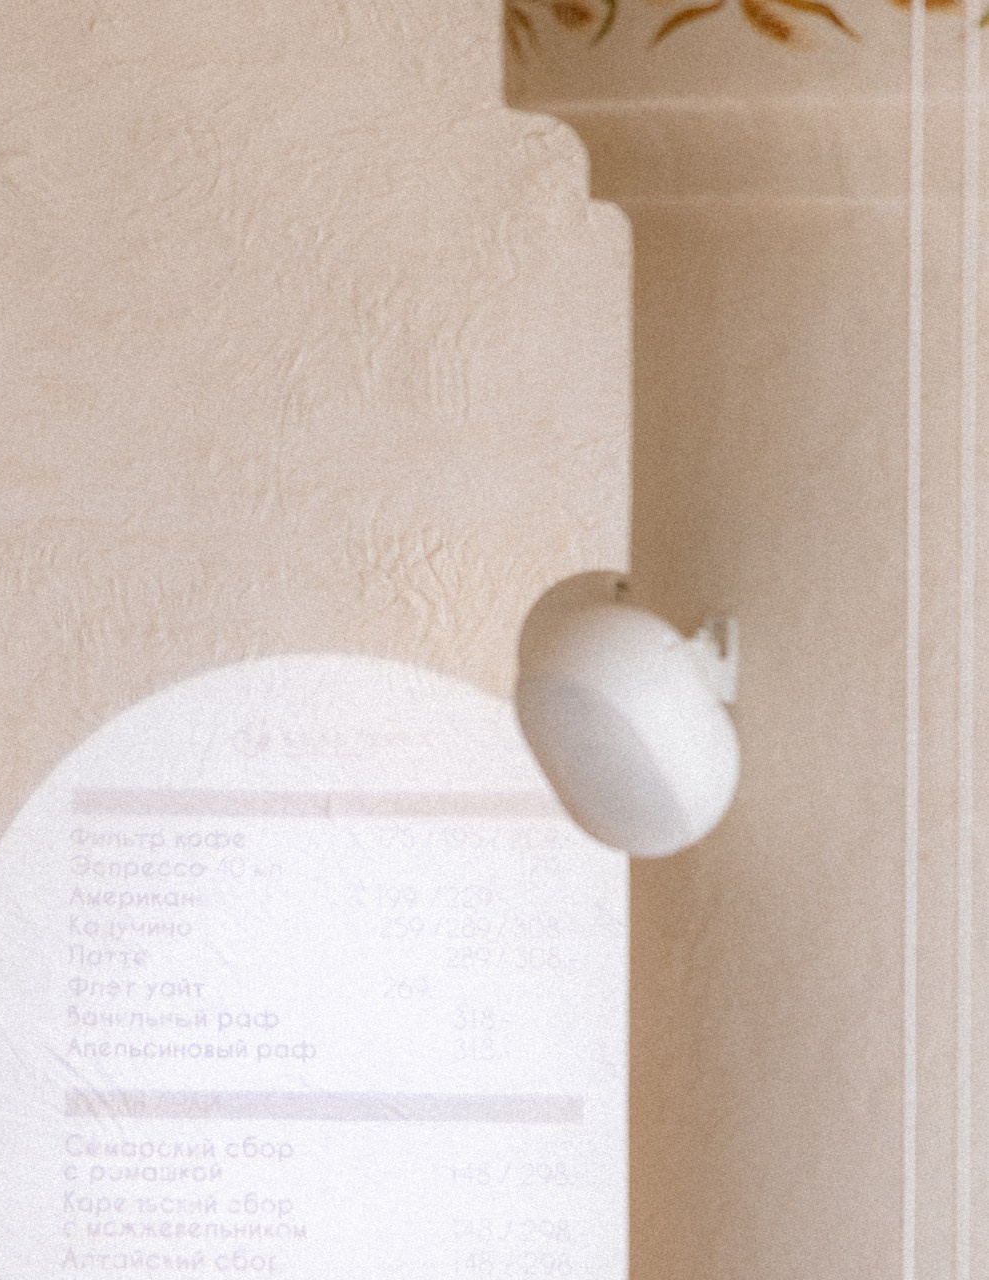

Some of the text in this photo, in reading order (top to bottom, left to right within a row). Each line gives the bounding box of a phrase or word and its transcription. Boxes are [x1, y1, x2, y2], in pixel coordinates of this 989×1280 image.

[69, 827, 247, 852] Фильтр кофе
[69, 854, 208, 881] Эспрессо
[144, 978, 206, 1001] уайт
[217, 1008, 281, 1032] раф
[66, 1037, 318, 1063] Апельсиновый раф
[225, 1135, 296, 1162] сбор
[63, 1161, 224, 1186] с ромашкой
[227, 1192, 295, 1219] сбор
[62, 1220, 78, 1239] с
[215, 1247, 279, 1275] сбор
